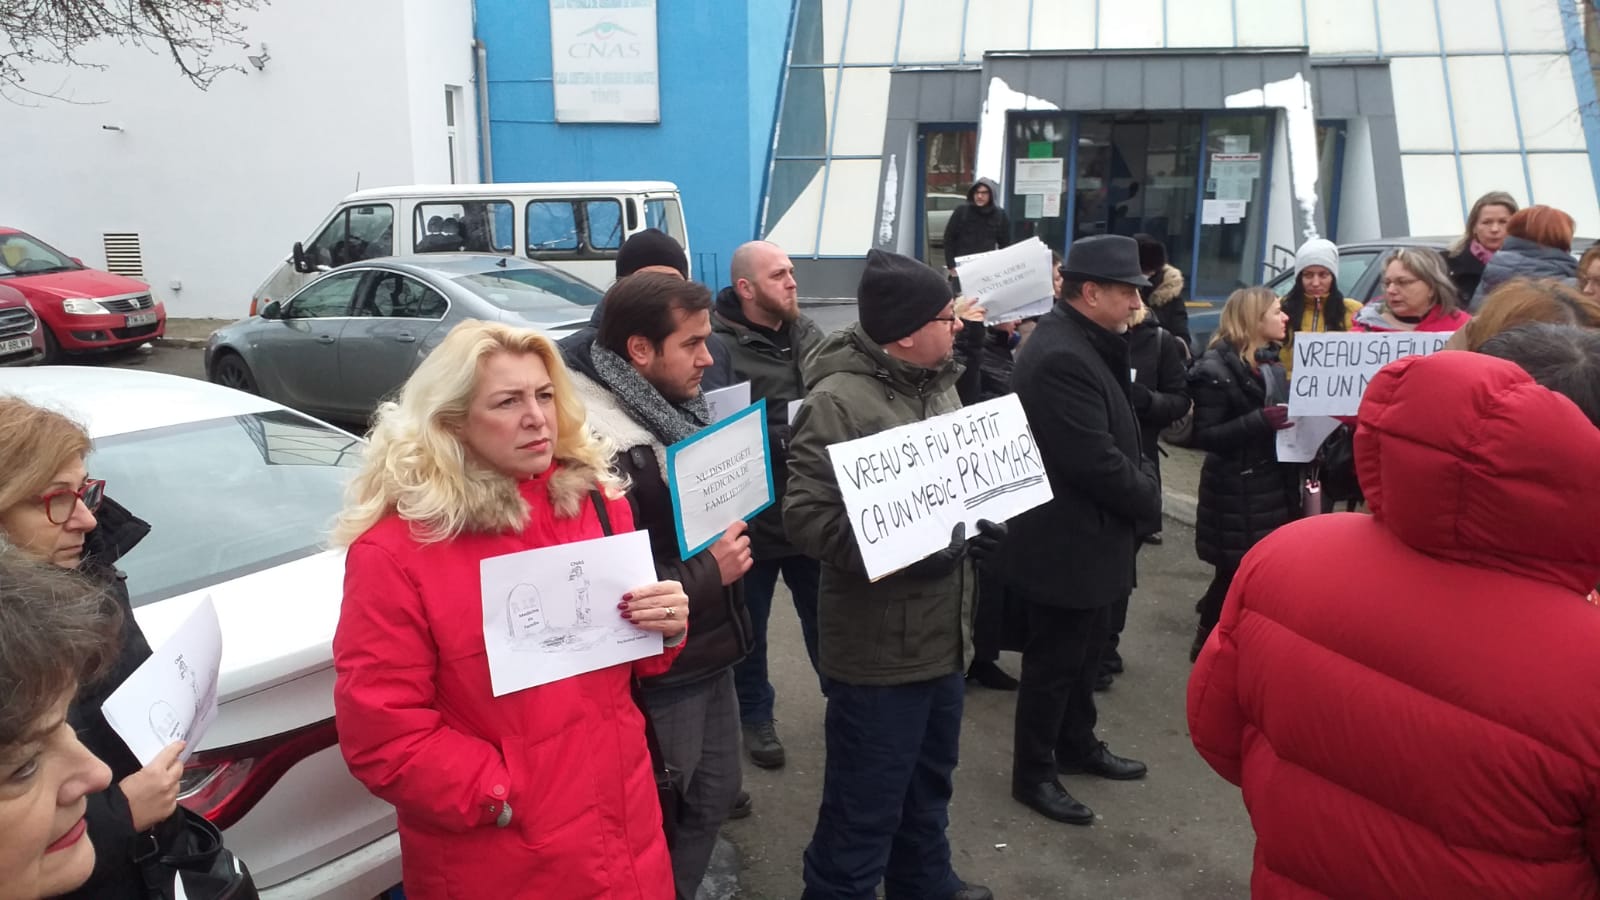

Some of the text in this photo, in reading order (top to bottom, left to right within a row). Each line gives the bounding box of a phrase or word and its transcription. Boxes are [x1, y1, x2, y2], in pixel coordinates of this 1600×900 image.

[567, 42, 641, 58] CNAS
[1298, 340, 1362, 368] VREAU
[1365, 335, 1390, 366] SĂ
[1296, 375, 1318, 398] CA
[1327, 375, 1353, 398] UN
[842, 446, 901, 490] VREAU
[925, 428, 949, 463] FIU
[703, 469, 741, 497] MEDICINA
[861, 504, 889, 544] CA
[888, 498, 913, 529] UN
[912, 476, 957, 520] MEDIC
